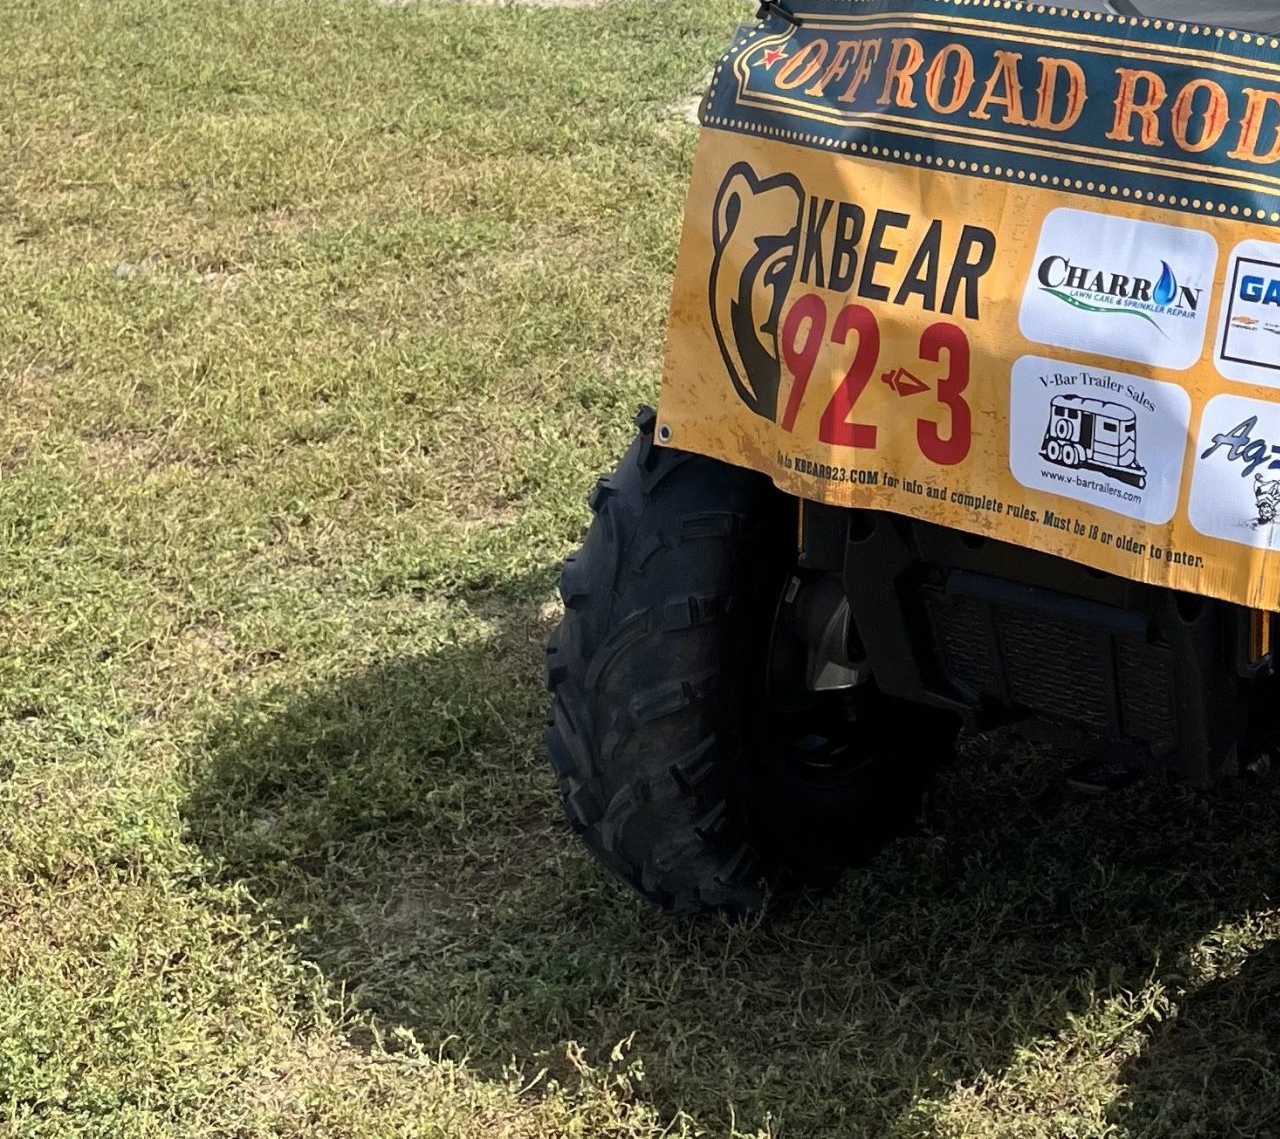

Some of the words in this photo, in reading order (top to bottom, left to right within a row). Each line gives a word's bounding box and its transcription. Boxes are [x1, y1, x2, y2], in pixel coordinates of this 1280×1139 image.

[800, 196, 997, 320] KBEAR
[1070, 289, 1093, 301] LAWN
[1093, 293, 1115, 305] CARE
[1115, 298, 1122, 306] &
[1124, 299, 1165, 314] SPRINKLER
[1166, 307, 1196, 320] REPAIR
[1039, 372, 1078, 389] V-Bar
[1080, 372, 1125, 393] Trailer
[1125, 384, 1157, 413] Sales
[1040, 469, 1142, 504] www.v-bartrailers.com
[794, 457, 879, 485] KBEAR923.COM
[882, 472, 900, 488] for
[903, 477, 923, 495] info
[926, 486, 947, 501] and
[950, 491, 1003, 513] complete
[1006, 503, 1039, 523] rules.
[1043, 509, 1072, 532] Must
[1073, 521, 1085, 536] be
[1088, 523, 1099, 540] 18
[1101, 530, 1113, 546] or
[1115, 535, 1145, 555] older
[1149, 543, 1162, 560] to
[1166, 550, 1204, 569] enter.
